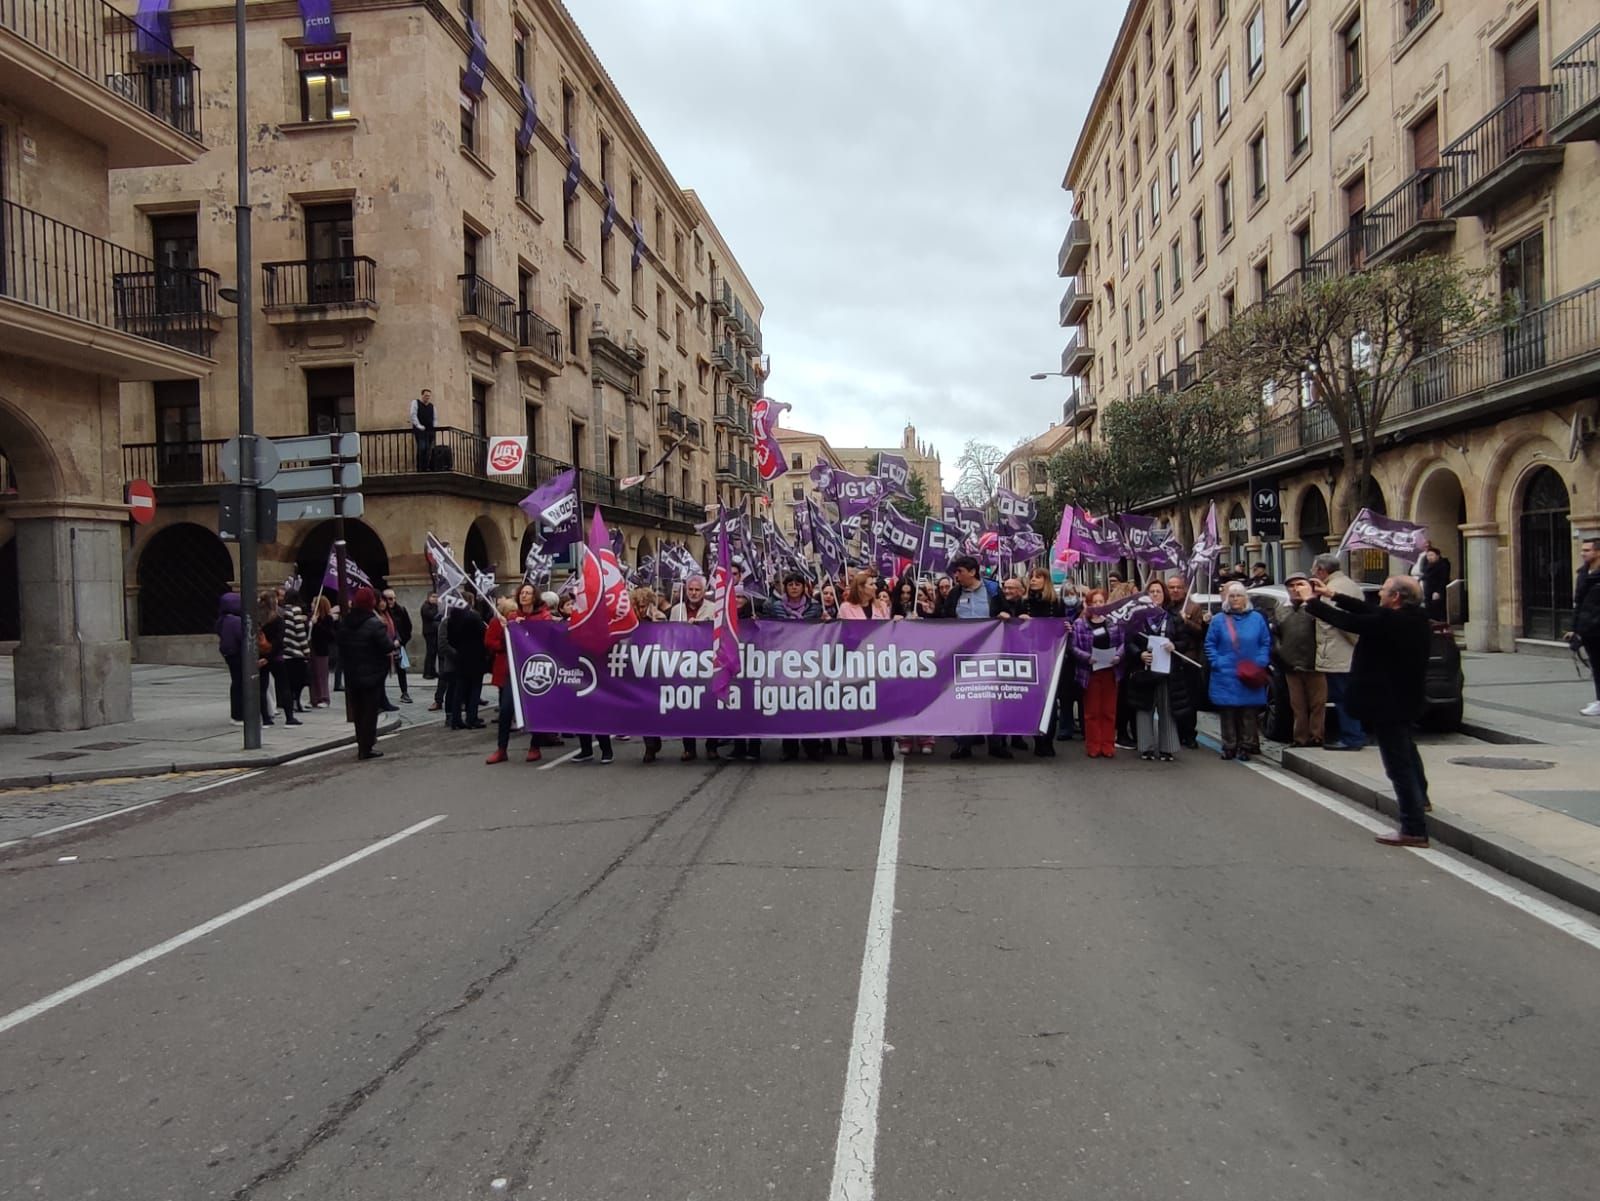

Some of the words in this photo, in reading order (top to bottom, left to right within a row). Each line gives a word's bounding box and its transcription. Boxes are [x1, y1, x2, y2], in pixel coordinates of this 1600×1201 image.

[306, 16, 331, 26] CCOO
[305, 51, 341, 62] CCOO
[495, 444, 519, 458] UGT
[608, 643, 937, 679] #VivasibresUnidas
[524, 661, 553, 678] UGT
[558, 667, 584, 677] Castilla
[960, 659, 1032, 678] CCOO
[955, 684, 999, 693] comisiones
[1000, 683, 1029, 693] obreras
[660, 684, 705, 714] por
[754, 681, 876, 716] igualdad
[955, 692, 966, 700] de
[967, 691, 996, 699] Castilla
[997, 692, 1003, 700] y
[1003, 691, 1023, 700] León
